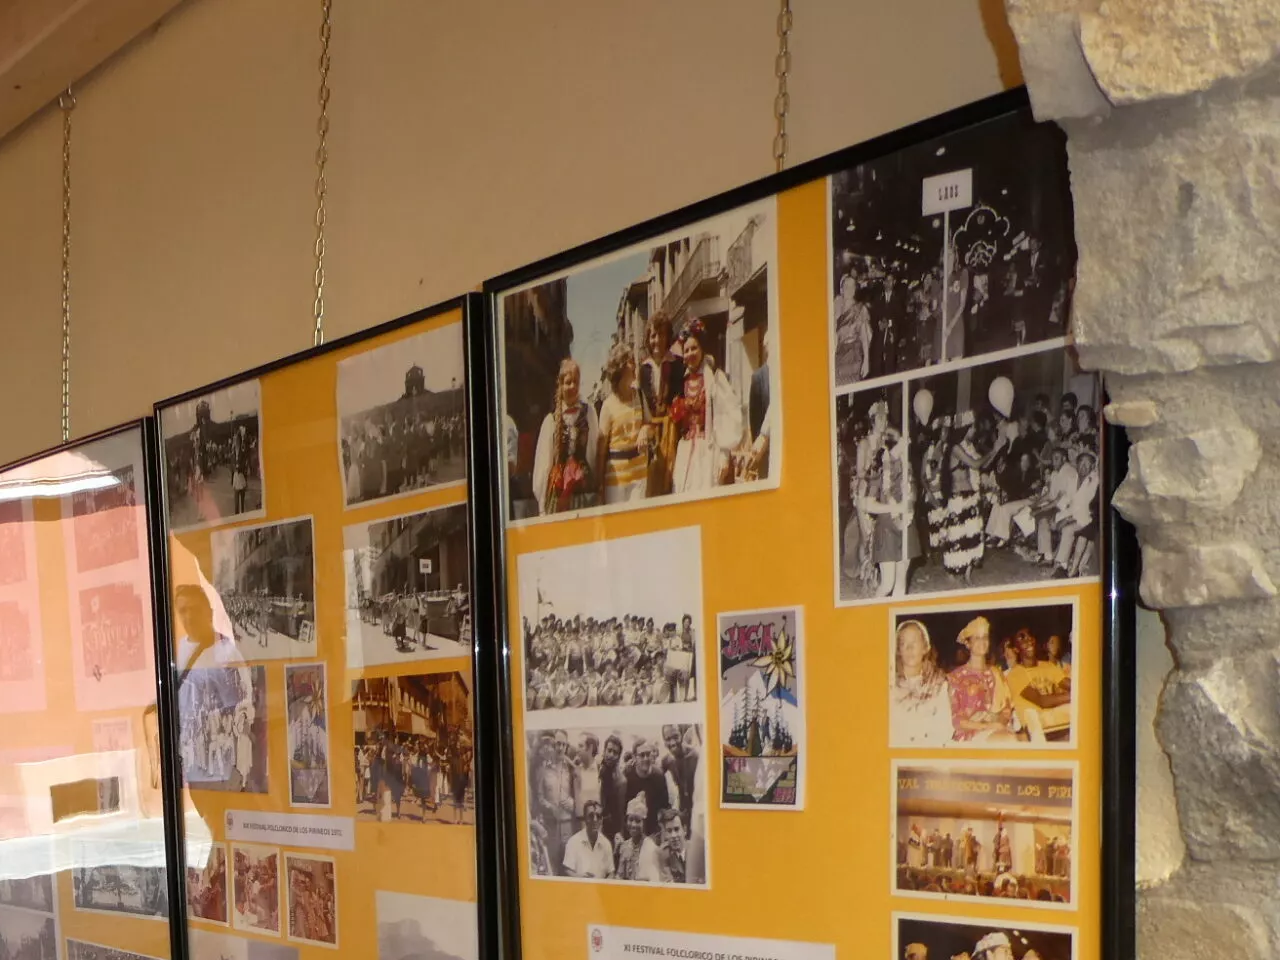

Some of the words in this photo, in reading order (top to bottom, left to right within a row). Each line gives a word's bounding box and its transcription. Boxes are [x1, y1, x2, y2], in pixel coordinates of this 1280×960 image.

[938, 184, 959, 201] LAOS
[996, 784, 1011, 796] DE
[1017, 785, 1041, 798] LOS
[623, 944, 631, 953] XI
[632, 945, 665, 957] FESTIVAL
[666, 948, 713, 960] FOLCLORICO
